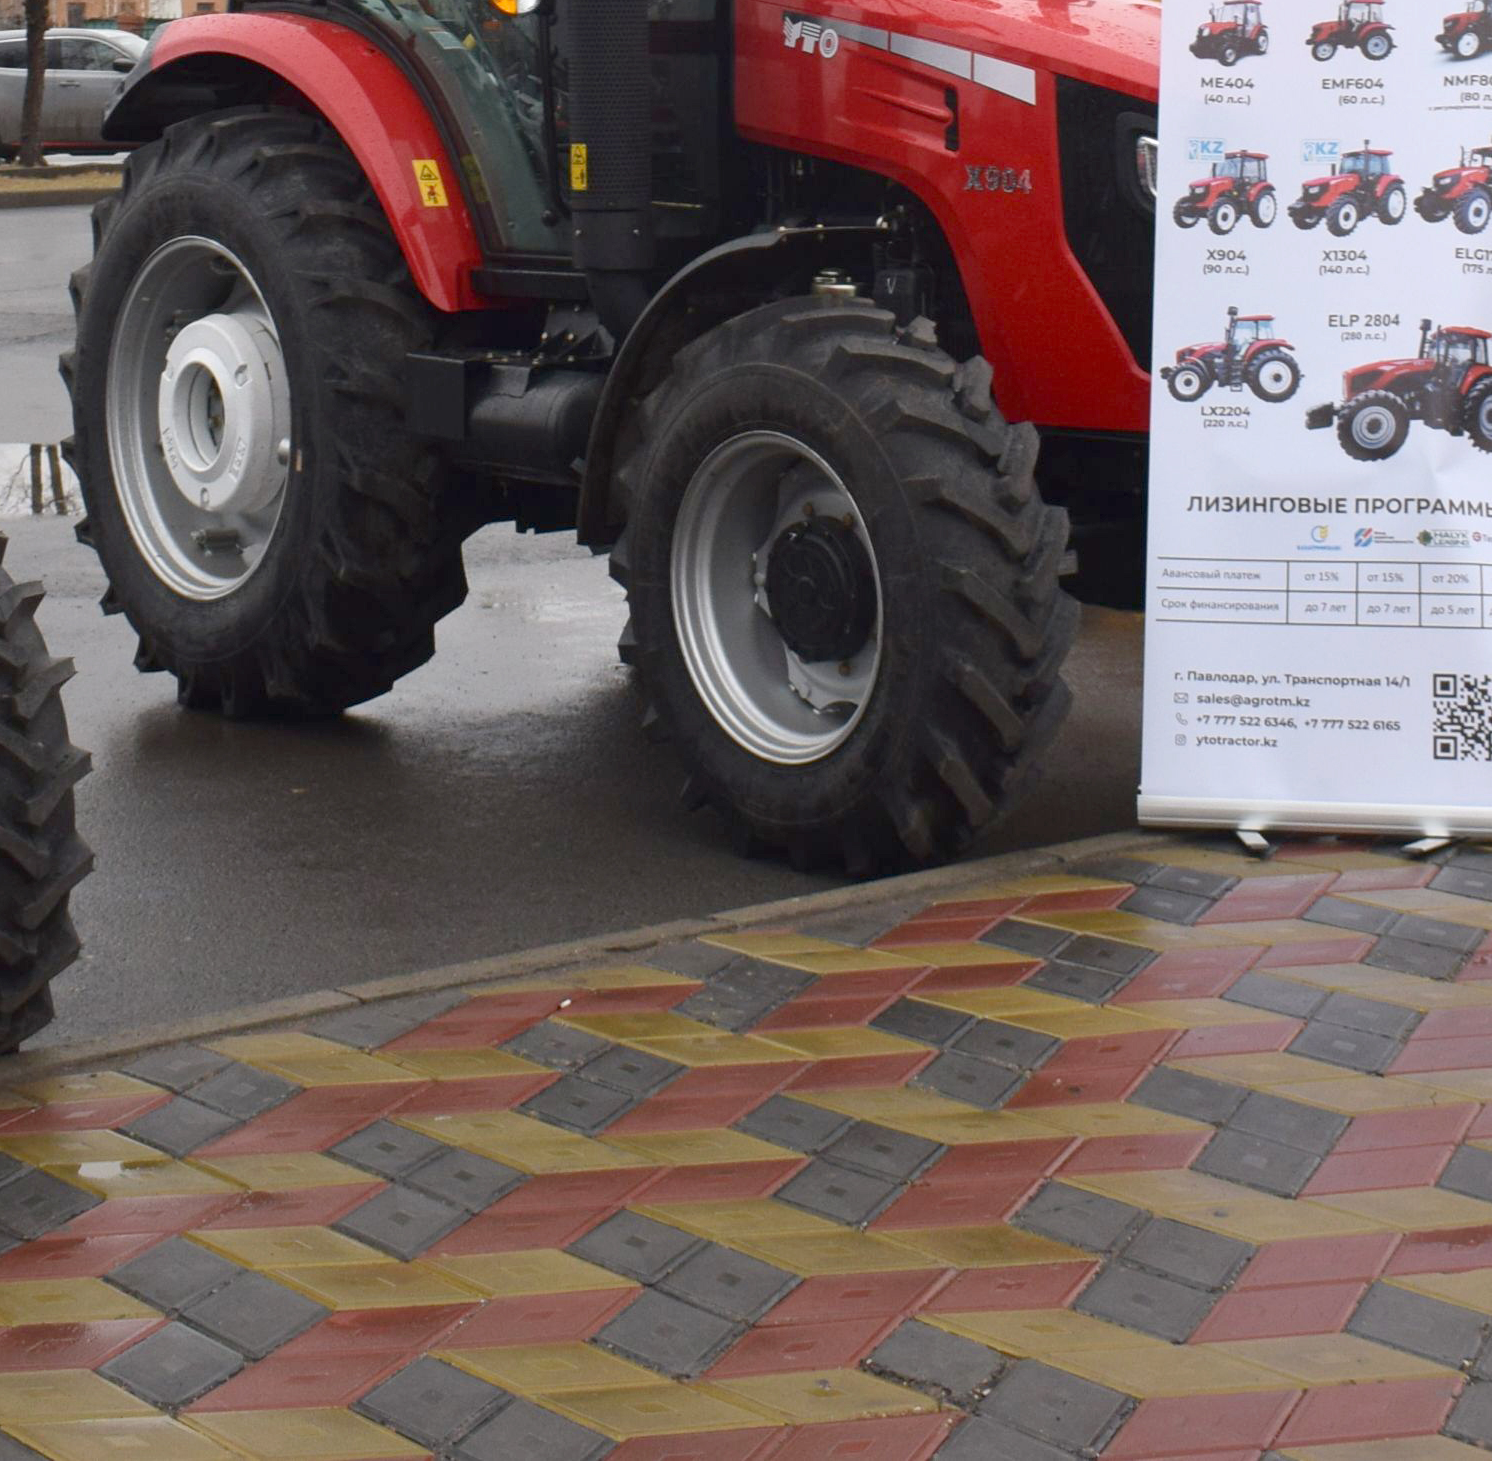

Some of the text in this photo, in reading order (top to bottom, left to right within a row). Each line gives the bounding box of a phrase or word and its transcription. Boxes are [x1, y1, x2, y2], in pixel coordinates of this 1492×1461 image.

[783, 16, 839, 58] YTO
[1200, 77, 1255, 89] ME404
[1321, 78, 1384, 90] EMF604
[1204, 94, 1223, 106] (40
[1338, 95, 1358, 106] (60
[1460, 92, 1480, 103] (80
[1200, 141, 1224, 154] KZ
[1316, 142, 1339, 155] KZ
[1206, 249, 1247, 261] X904
[1323, 250, 1368, 262] X1304
[1203, 264, 1222, 276] (90
[1319, 265, 1343, 276] (140
[1462, 263, 1484, 275] (175
[1328, 313, 1401, 327] ELP 2804
[1201, 406, 1251, 417] LX2204
[1203, 418, 1225, 429] (220
[1187, 495, 1347, 514] ЛИЗИНГОВЫЕ
[1162, 568, 1261, 580] Авансовый платеж
[1304, 571, 1339, 582] от 15%
[1367, 572, 1404, 583] от 15%
[1432, 573, 1469, 584] от 20%
[1161, 598, 1279, 611] Срок финансирования
[1304, 603, 1318, 613] до
[1329, 604, 1347, 612] лет
[1367, 605, 1381, 614] до
[1393, 605, 1411, 614] лет
[1431, 606, 1444, 615] до
[1174, 670, 1410, 688] г. Павлодар, ул. Транспортная 14/1
[1197, 693, 1310, 707] sales@agrotm.kz
[1197, 714, 1401, 731] +7 777 522 6346, +7 777 522 6165
[1196, 736, 1278, 748] ytotractor.kz
